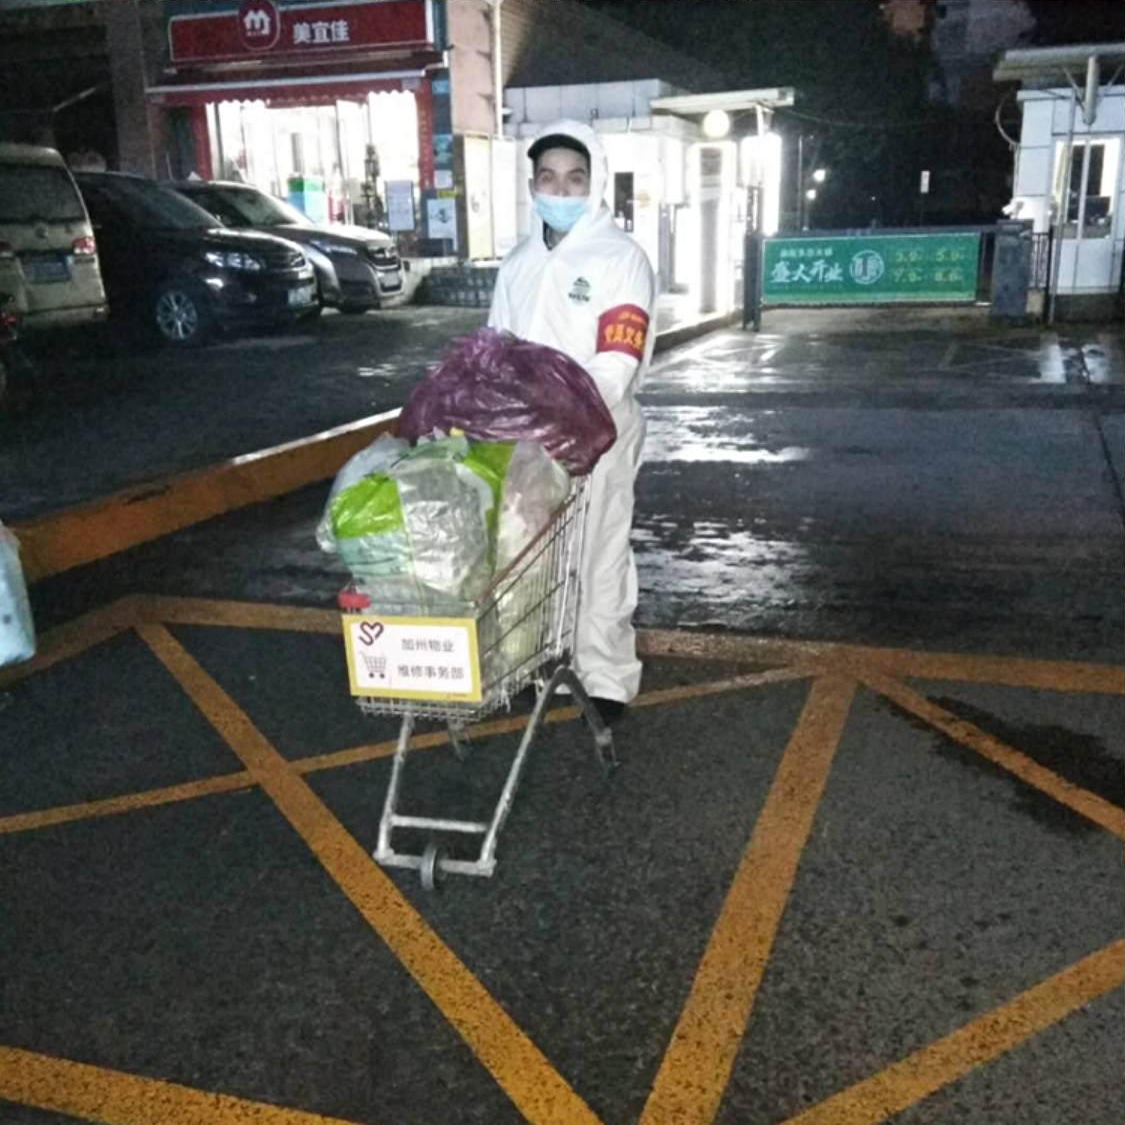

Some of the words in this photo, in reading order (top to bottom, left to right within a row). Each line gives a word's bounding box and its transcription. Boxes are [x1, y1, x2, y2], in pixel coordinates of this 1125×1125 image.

[293, 20, 350, 44] 美宜佳
[401, 638, 455, 653] 加州物业
